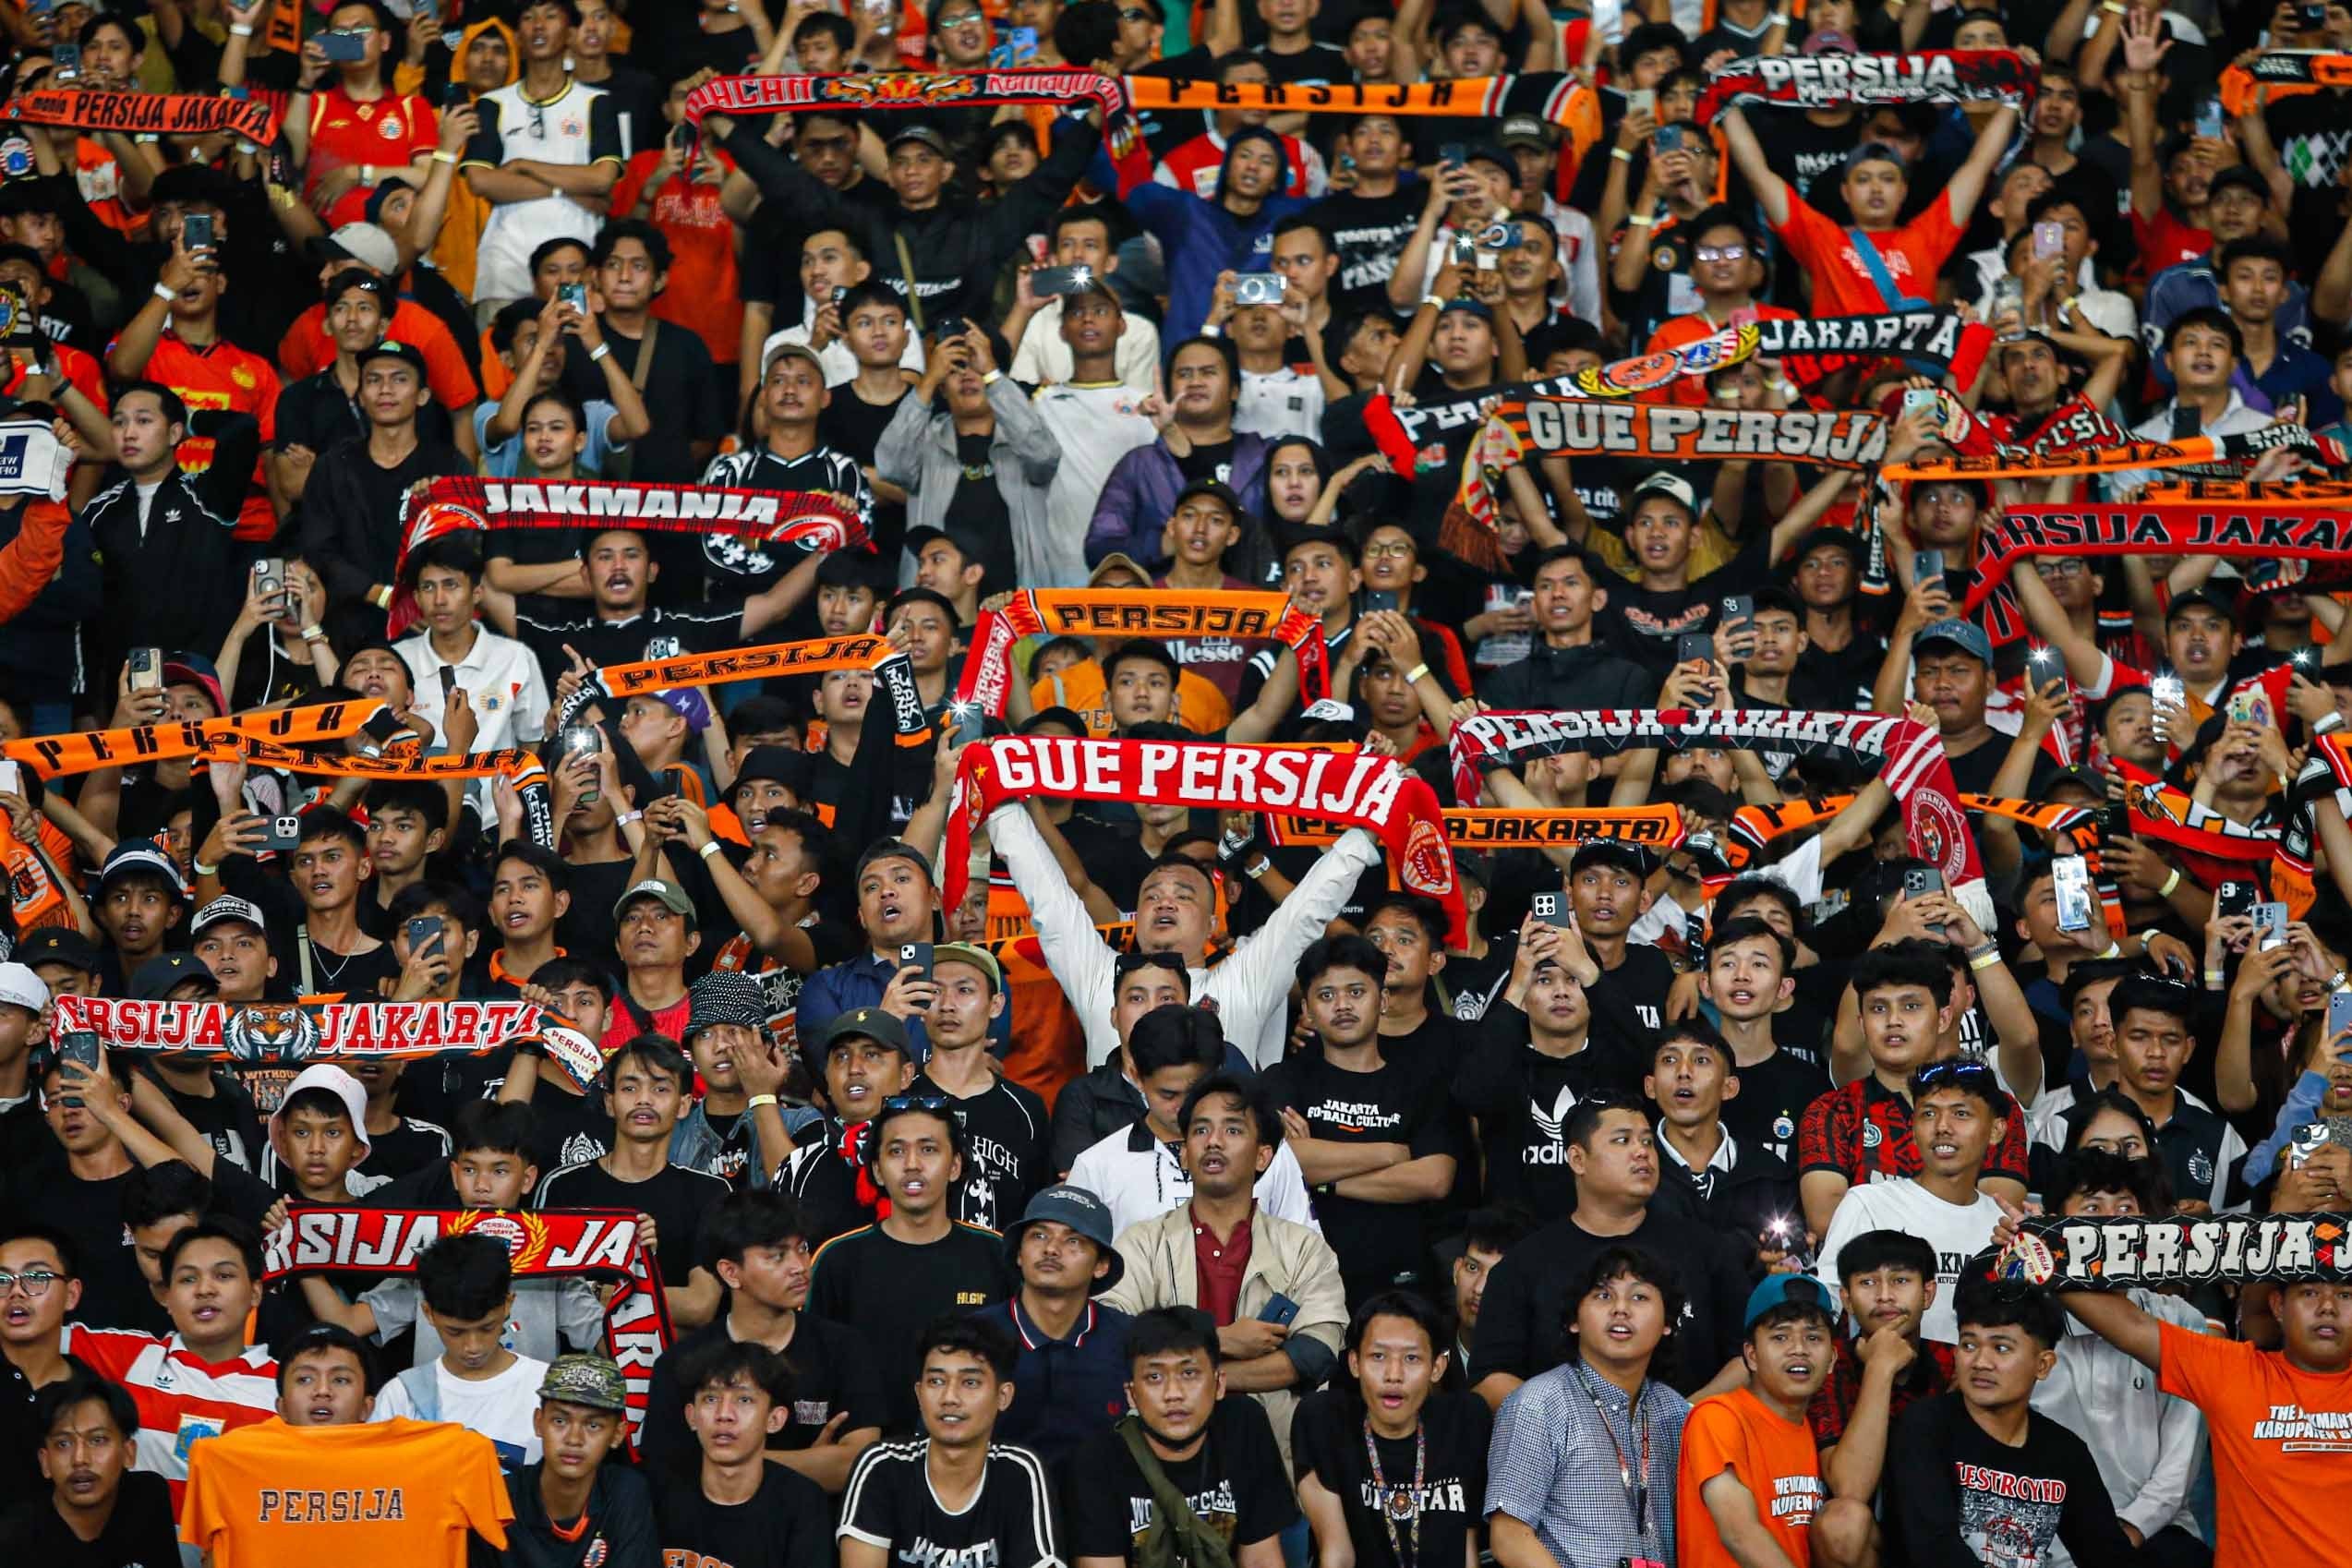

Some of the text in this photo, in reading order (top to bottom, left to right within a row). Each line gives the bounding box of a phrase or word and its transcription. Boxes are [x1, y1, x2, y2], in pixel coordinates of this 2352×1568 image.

[1756, 54, 1959, 92] PERSIJA
[73, 92, 164, 127] PERSIJA
[1760, 313, 1961, 360] JAKARTA
[1526, 399, 1888, 464] GUE PERSIJA
[483, 484, 779, 525] JAKMANIA
[1976, 513, 2172, 577] ERSIJA
[1054, 604, 1270, 635] PERSIJA
[621, 637, 876, 691] PERSIJA
[885, 666, 912, 731] MANIA
[897, 673, 922, 718] JAK
[1682, 708, 1902, 756] JAKARTA
[990, 738, 1405, 826] GUE PERSIJA
[1341, 905, 1365, 914] OUTH
[50, 993, 543, 1055] ERSIJA JAKARTA
[551, 1029, 598, 1065] PERSIJA
[244, 1068, 299, 1080] WITHOU
[1322, 1098, 1380, 1116] JAKARTA
[973, 1135, 1019, 1180] HIGH
[2032, 1241, 2051, 1272] PERSIJA
[2061, 1219, 2315, 1283] PERSIJA
[2269, 1404, 2297, 1421] THE
[258, 1488, 406, 1524] PERSIJA
[899, 1536, 1000, 1568] JAKARTA
